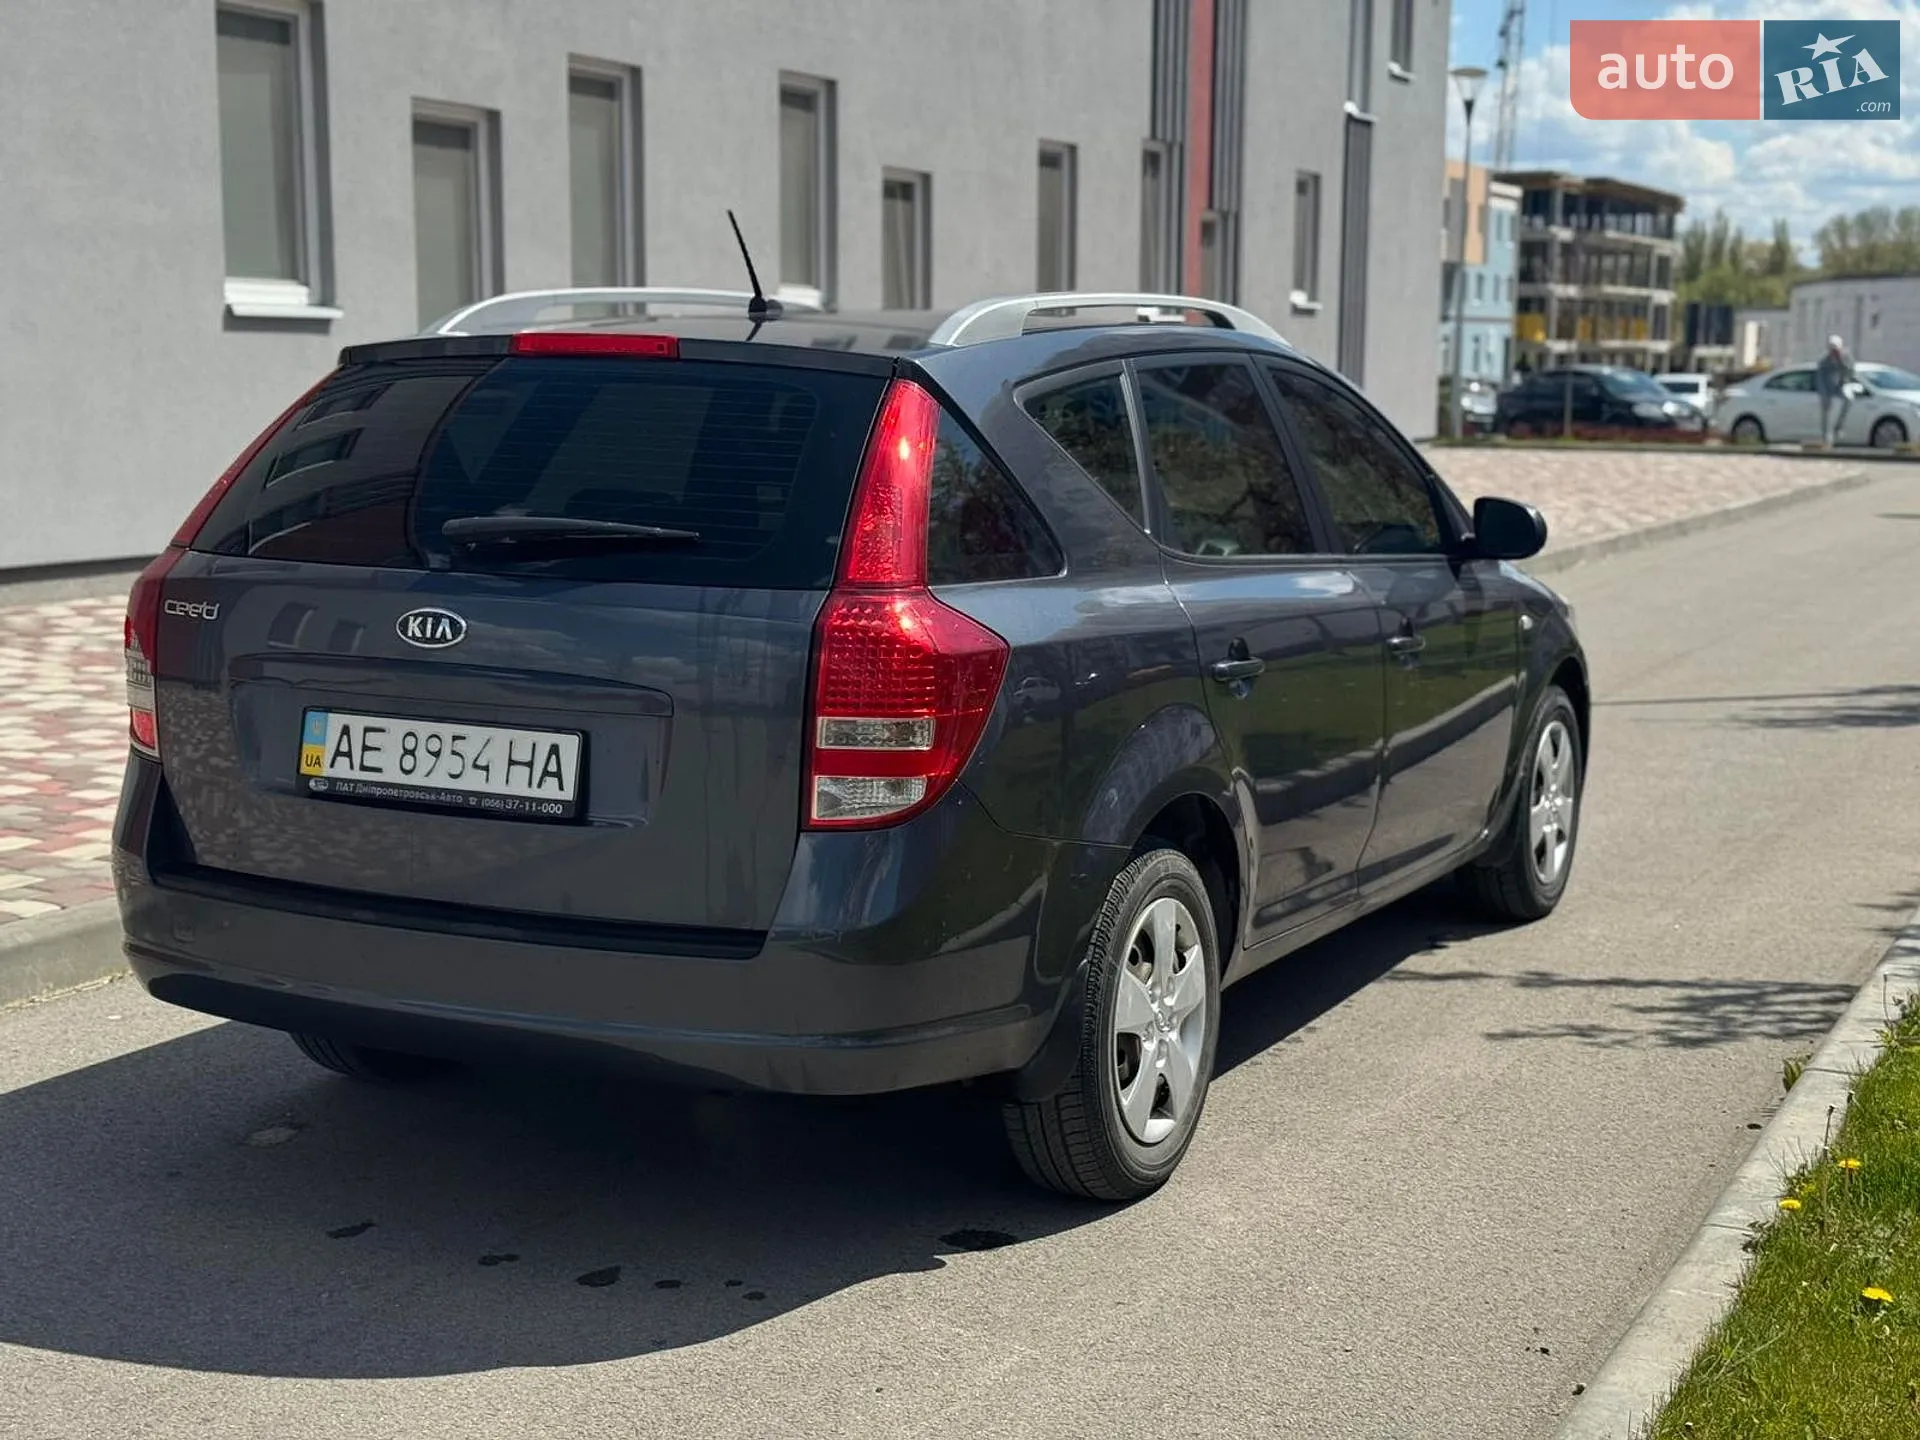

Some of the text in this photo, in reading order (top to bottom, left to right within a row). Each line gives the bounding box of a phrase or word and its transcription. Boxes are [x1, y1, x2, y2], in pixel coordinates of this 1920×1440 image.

[407, 615, 453, 640] KIA
[304, 752, 322, 769] UA
[330, 724, 565, 792] AE 8954 HA
